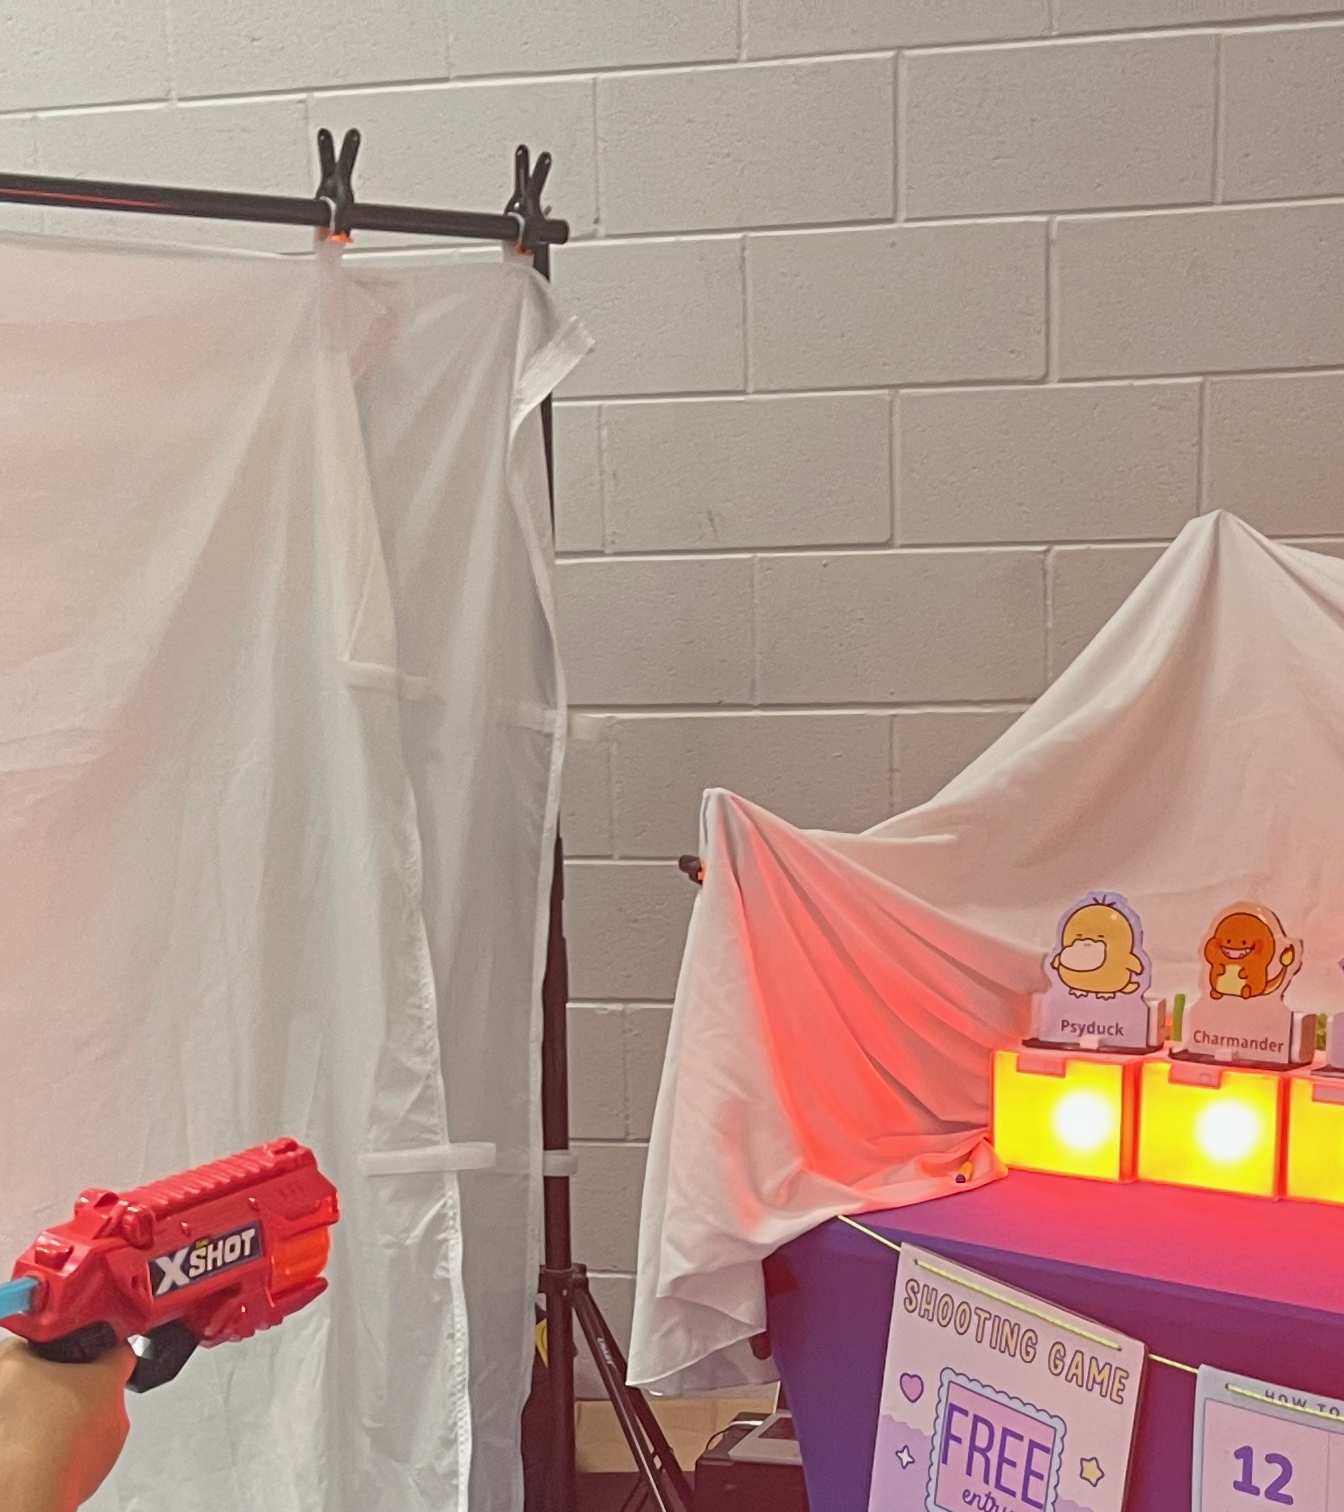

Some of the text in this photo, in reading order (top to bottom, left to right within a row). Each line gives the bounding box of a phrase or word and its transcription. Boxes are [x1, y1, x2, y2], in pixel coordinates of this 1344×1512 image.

[1060, 1018, 1124, 1038] Psyduck
[1192, 1028, 1285, 1054] Charmander
[903, 1277, 1130, 1405] SHOOTING GAME
[941, 1402, 1053, 1510] FREE
[1232, 1445, 1294, 1506] 12
